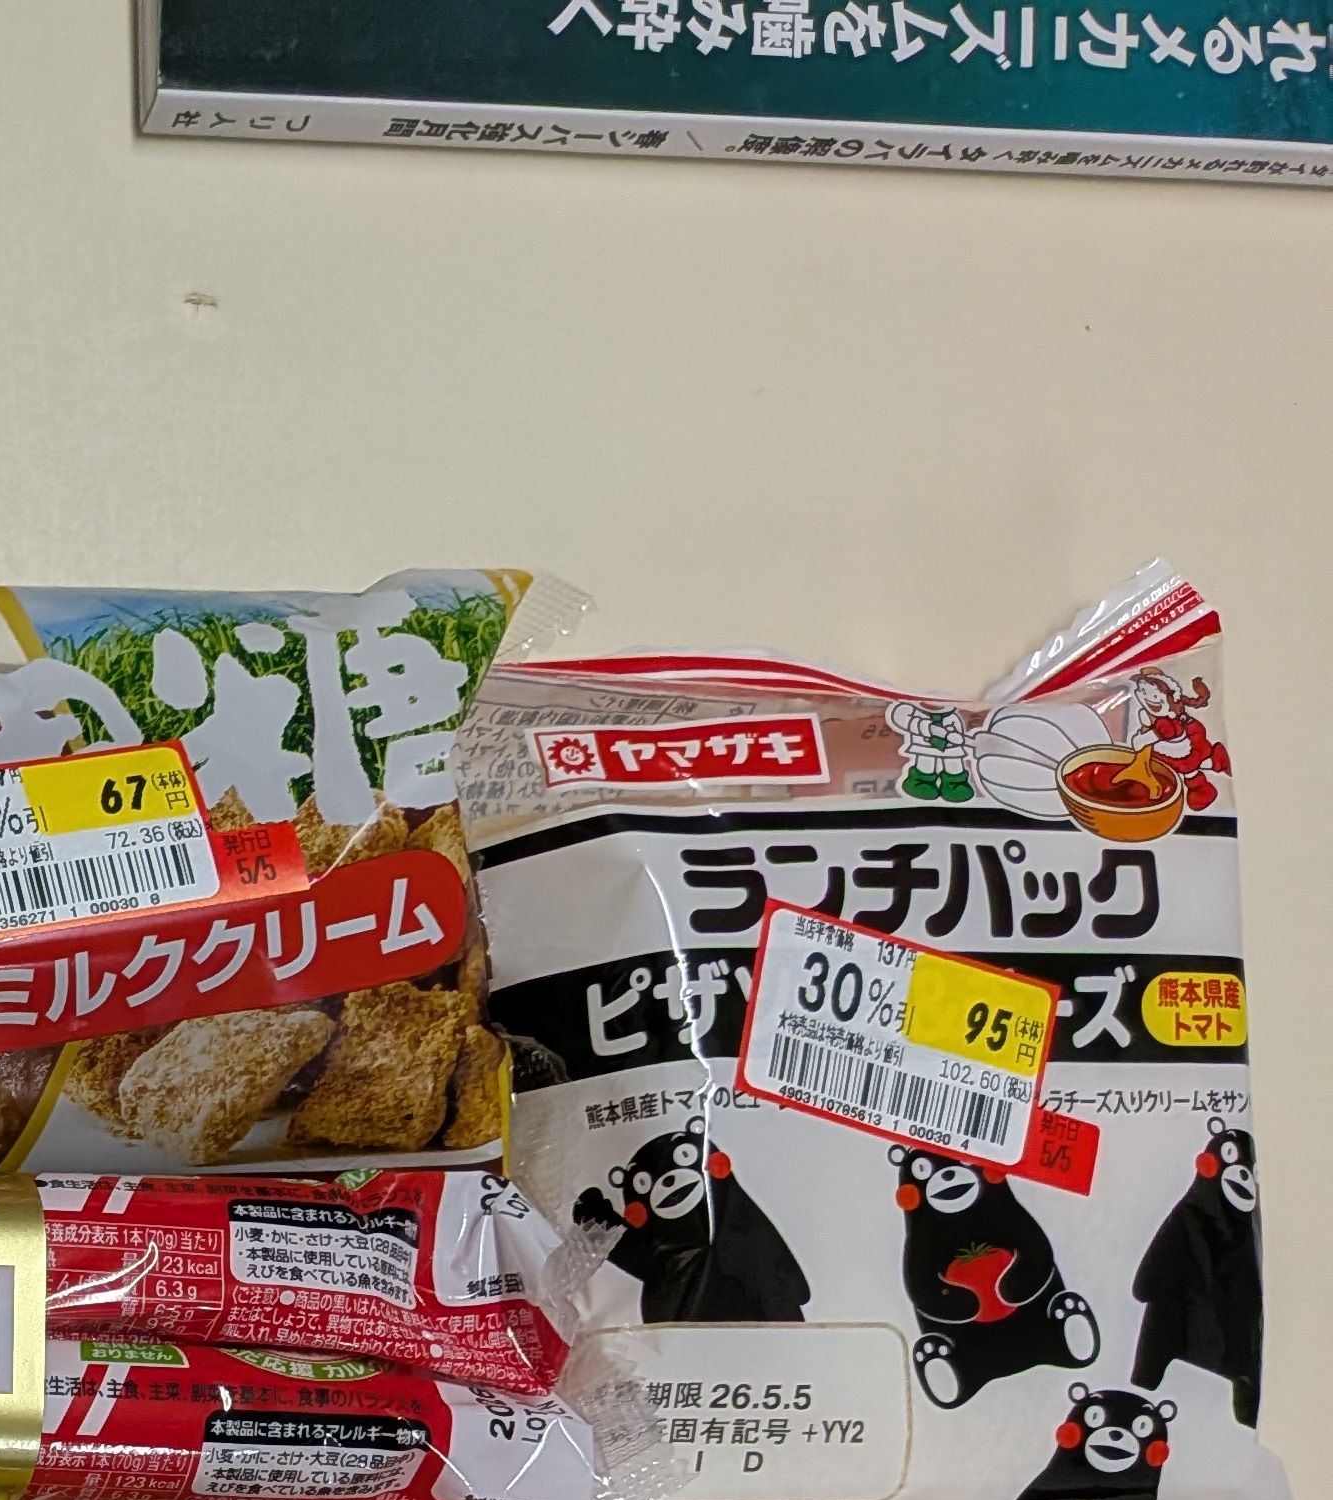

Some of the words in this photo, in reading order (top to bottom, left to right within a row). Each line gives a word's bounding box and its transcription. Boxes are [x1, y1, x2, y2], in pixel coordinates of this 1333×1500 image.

[548, 0, 1333, 82] れるメカニズムを噛み砕く
[171, 110, 311, 134] つり人社
[609, 731, 806, 774] ヤマザキ
[100, 774, 147, 814] 67
[105, 825, 164, 851] 72.36
[223, 830, 273, 857] 発行日
[235, 857, 279, 886] 5/5
[679, 838, 1161, 940] ランチパック
[88, 896, 140, 916] 00030
[797, 951, 916, 1036] 30%引
[1157, 977, 1242, 1009] 熊本県産
[964, 1002, 1014, 1051] 95
[1174, 1012, 1233, 1042] トマト
[938, 1059, 1002, 1092] 102.60
[779, 1085, 883, 1127] 4903110785613
[908, 1123, 951, 1146] 00030
[1039, 1141, 1072, 1173] 5/5
[709, 1382, 813, 1410] 26.5.5
[800, 1418, 866, 1445] +YY2
[742, 1449, 764, 1473] D
